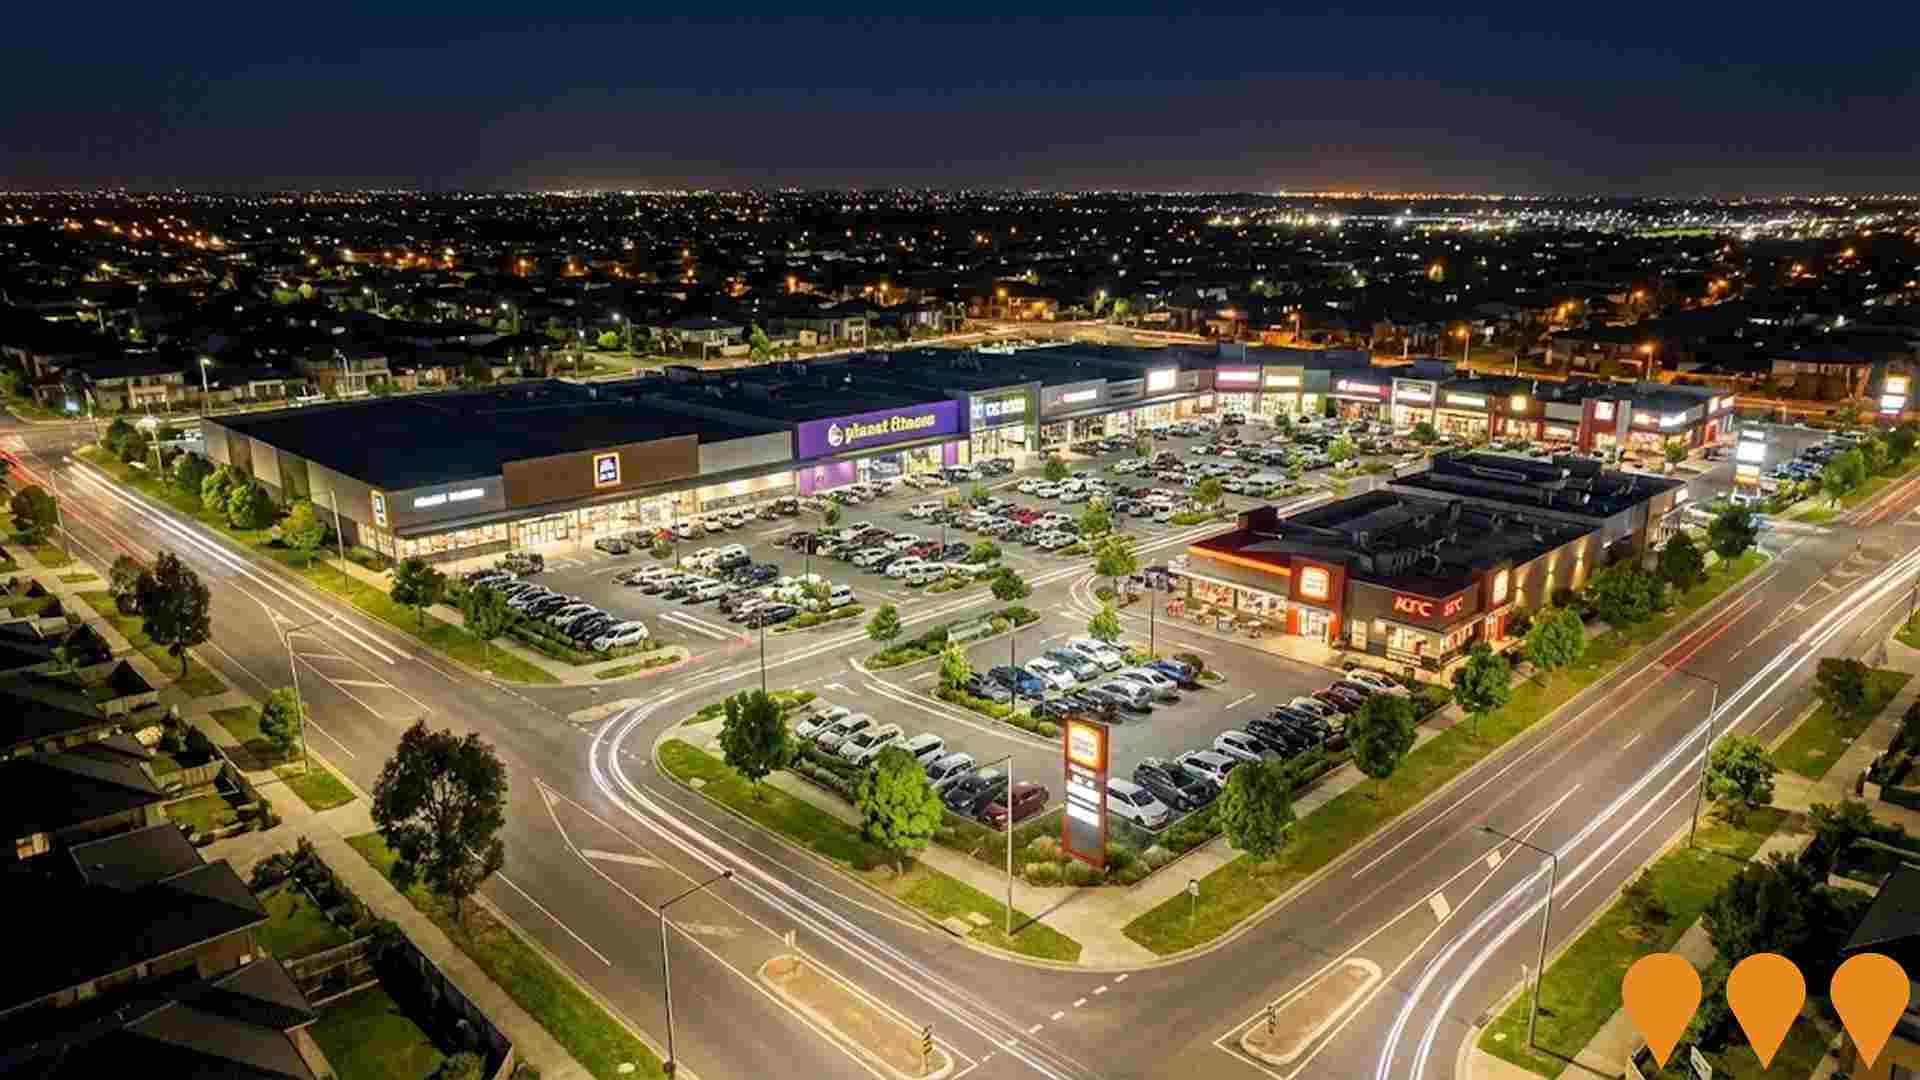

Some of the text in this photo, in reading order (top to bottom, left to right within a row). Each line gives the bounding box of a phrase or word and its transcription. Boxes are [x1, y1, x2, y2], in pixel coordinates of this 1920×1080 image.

[845, 414, 936, 444] planet fitness
[1394, 596, 1431, 617] KFC
